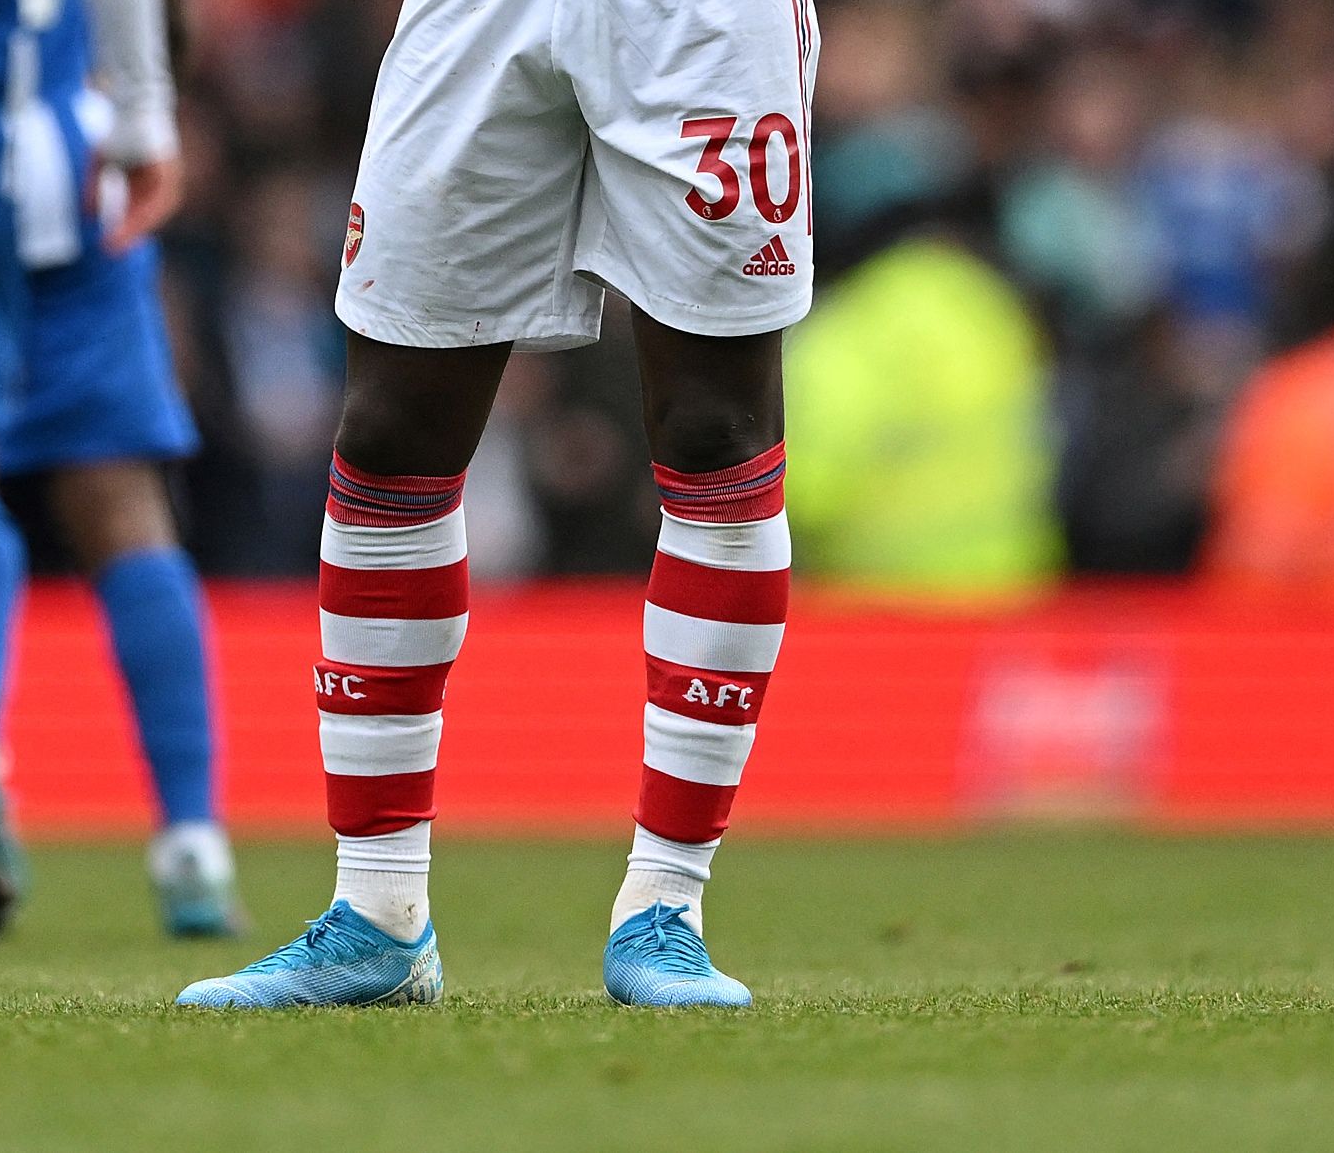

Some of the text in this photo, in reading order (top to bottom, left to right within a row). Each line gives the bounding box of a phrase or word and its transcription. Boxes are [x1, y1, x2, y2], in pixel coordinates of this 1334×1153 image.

[680, 112, 801, 224] 30
[742, 260, 796, 277] adidas
[681, 678, 754, 710] AFC
